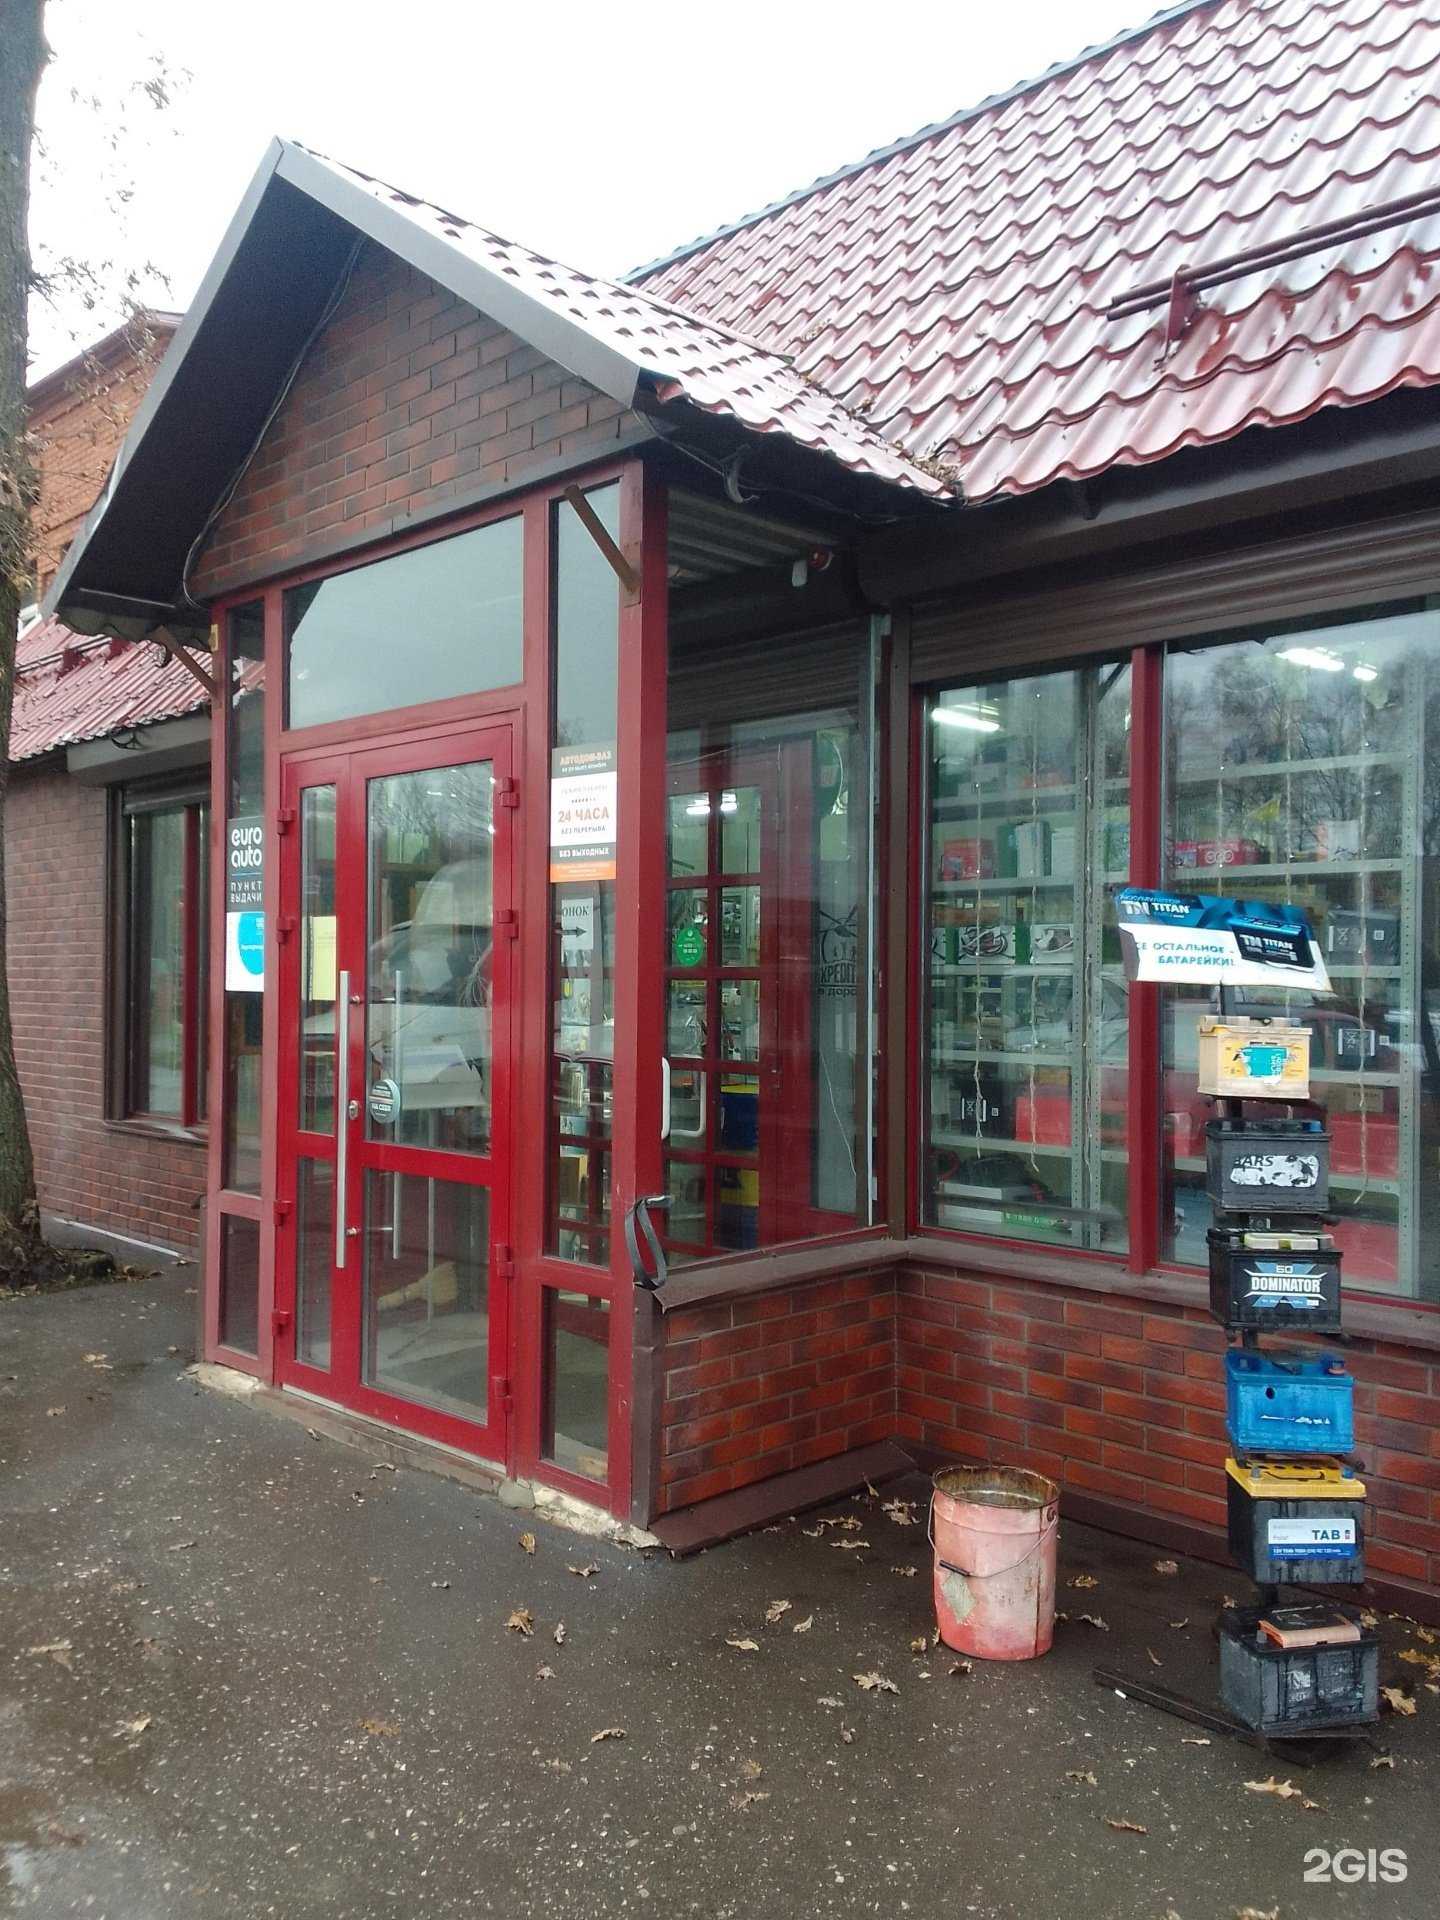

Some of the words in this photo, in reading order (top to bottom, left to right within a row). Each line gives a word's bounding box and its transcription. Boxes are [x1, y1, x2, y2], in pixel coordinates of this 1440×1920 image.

[559, 810, 572, 823] 24
[575, 807, 609, 820] ЧАСА
[231, 826, 262, 847] euro
[231, 846, 262, 868] auto
[559, 850, 571, 858] БЕЗ
[231, 881, 262, 892] ПУНКТ
[231, 892, 262, 903] ВЫДАЧИ
[1151, 902, 1190, 914] TITAN
[1136, 942, 1147, 950] СЕ
[1153, 942, 1224, 954] ОСТАЛЬНОЕ
[1262, 938, 1294, 950] TITAN
[1251, 1277, 1321, 1293] DOMINATOR
[1312, 1529, 1341, 1541] TAB
